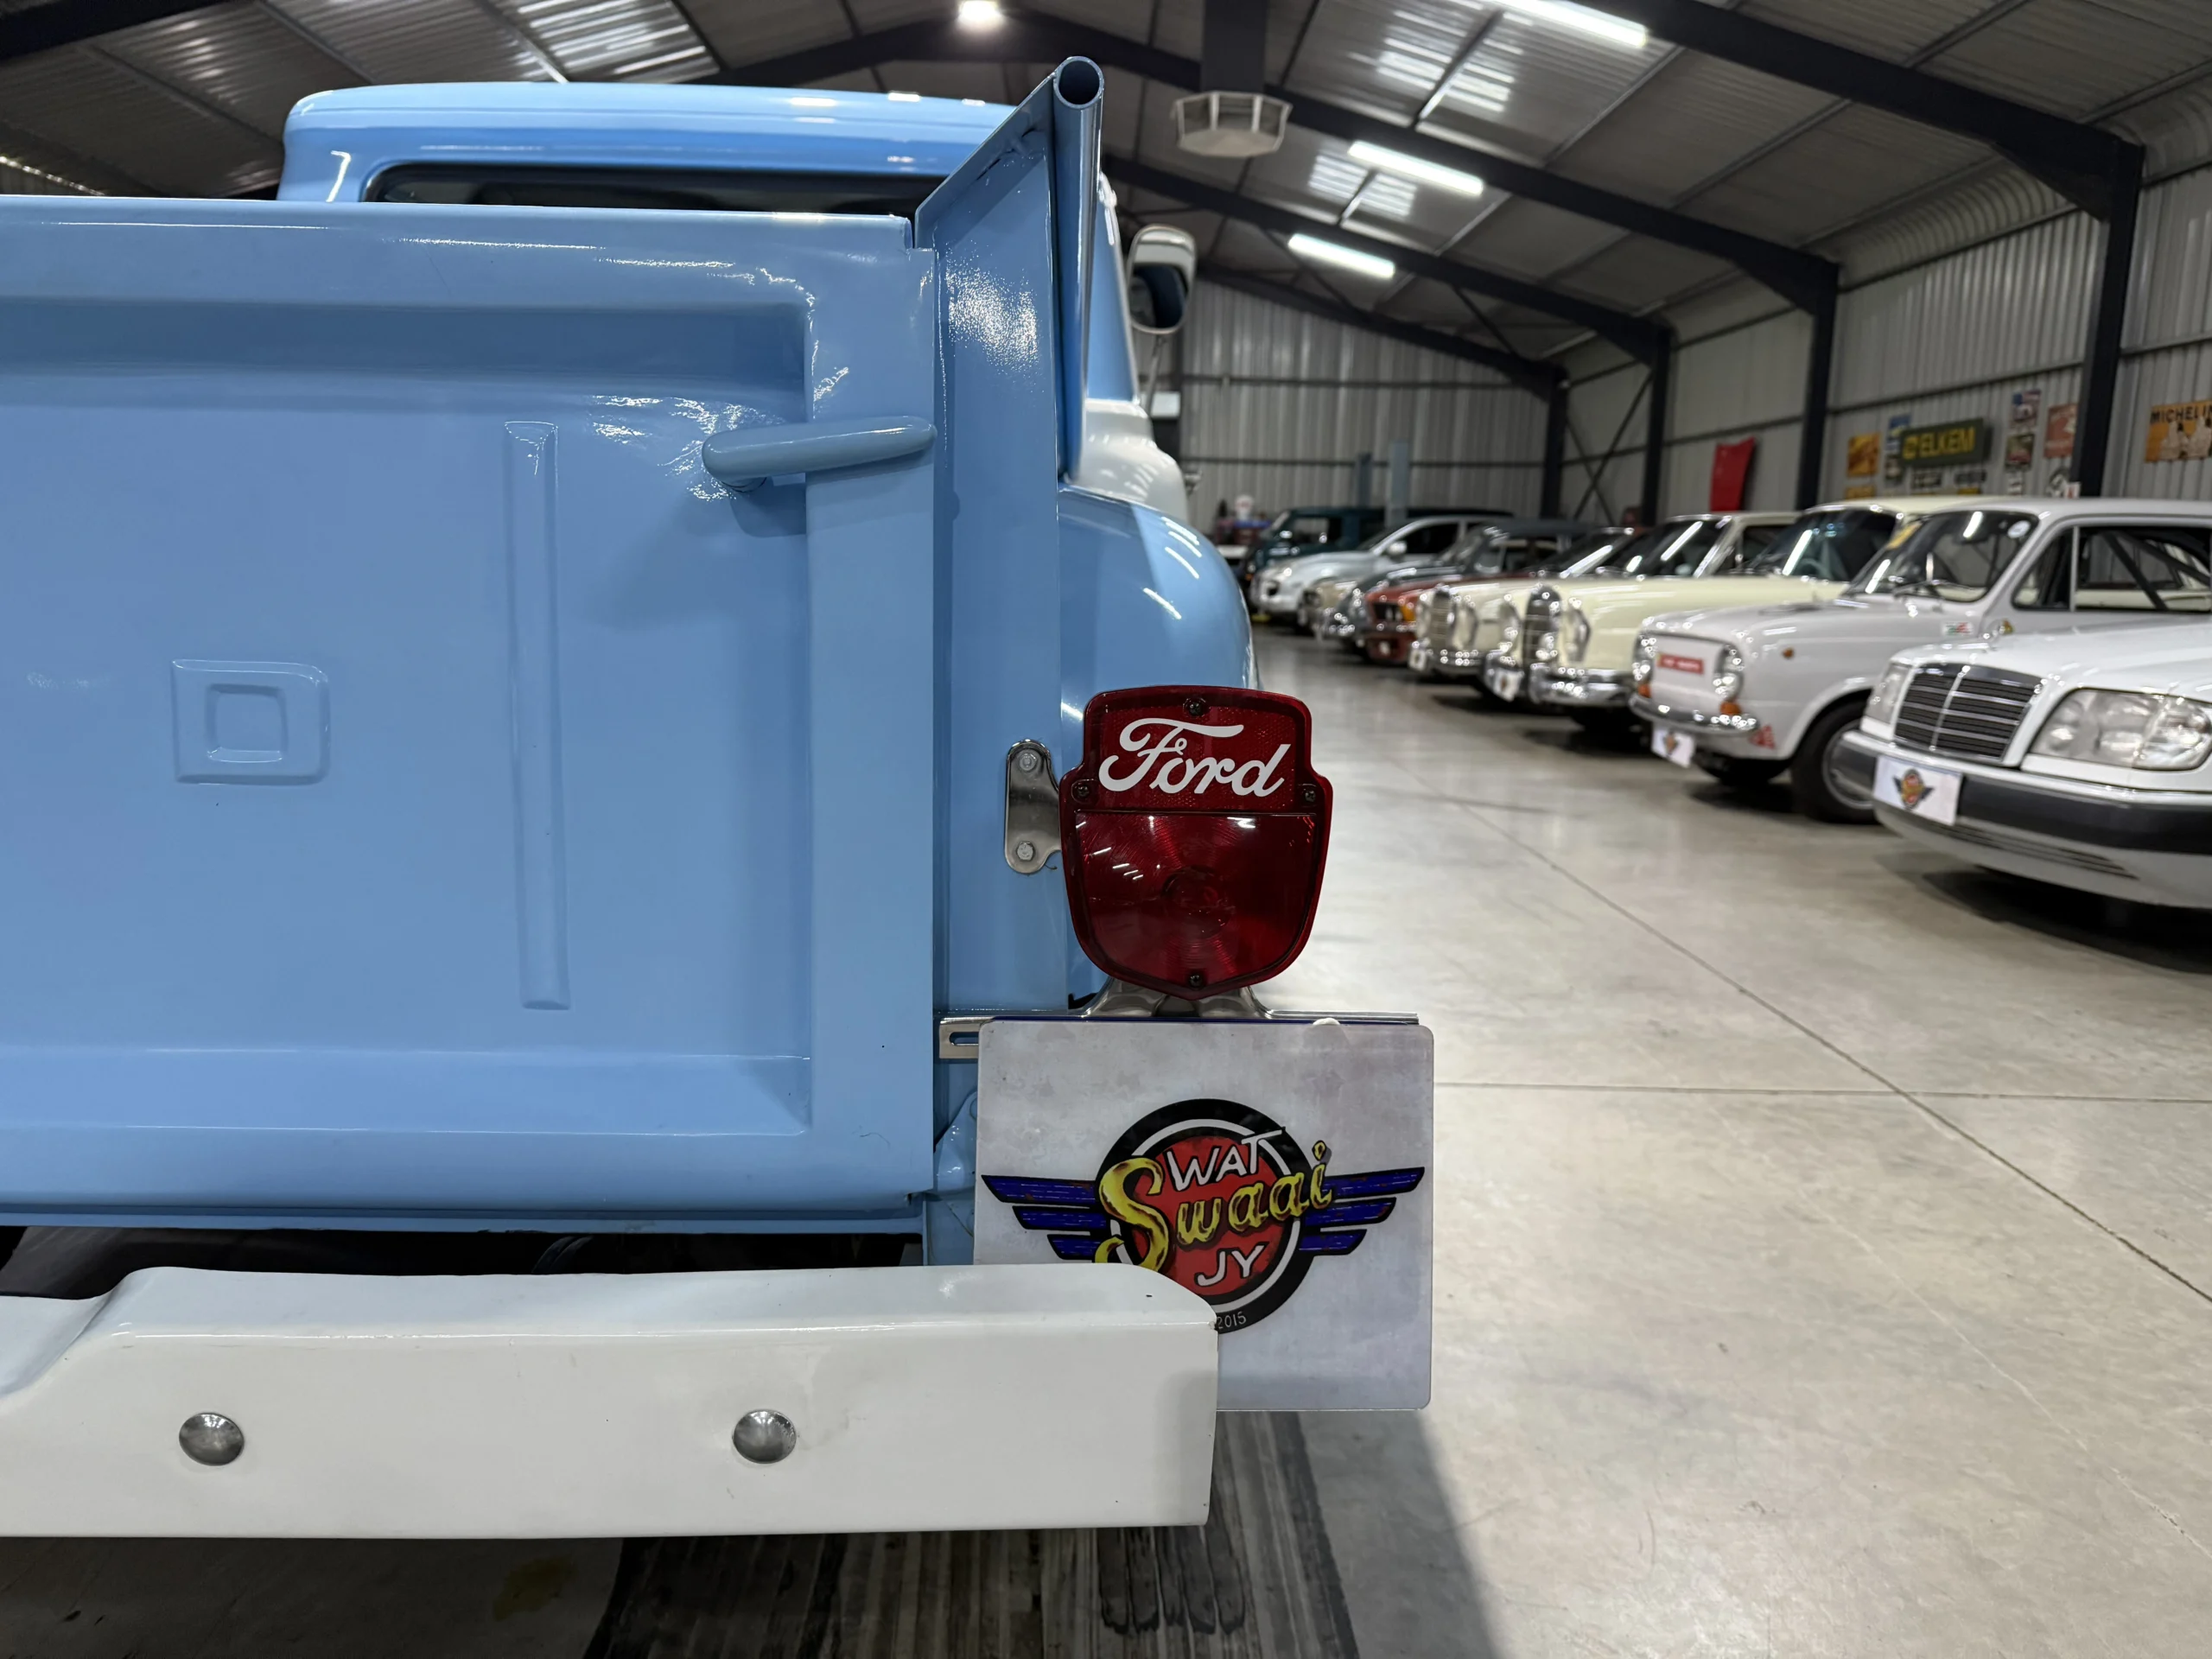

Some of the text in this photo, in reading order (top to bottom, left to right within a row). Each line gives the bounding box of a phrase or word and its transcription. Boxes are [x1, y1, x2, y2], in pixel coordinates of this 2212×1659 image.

[1098, 718, 1291, 797] Ford
[1166, 1129, 1282, 1192] WAT
[1094, 1141, 1333, 1271] Swaai
[1197, 1245, 1265, 1287] JY
[1217, 1311, 1247, 1329] 2015
